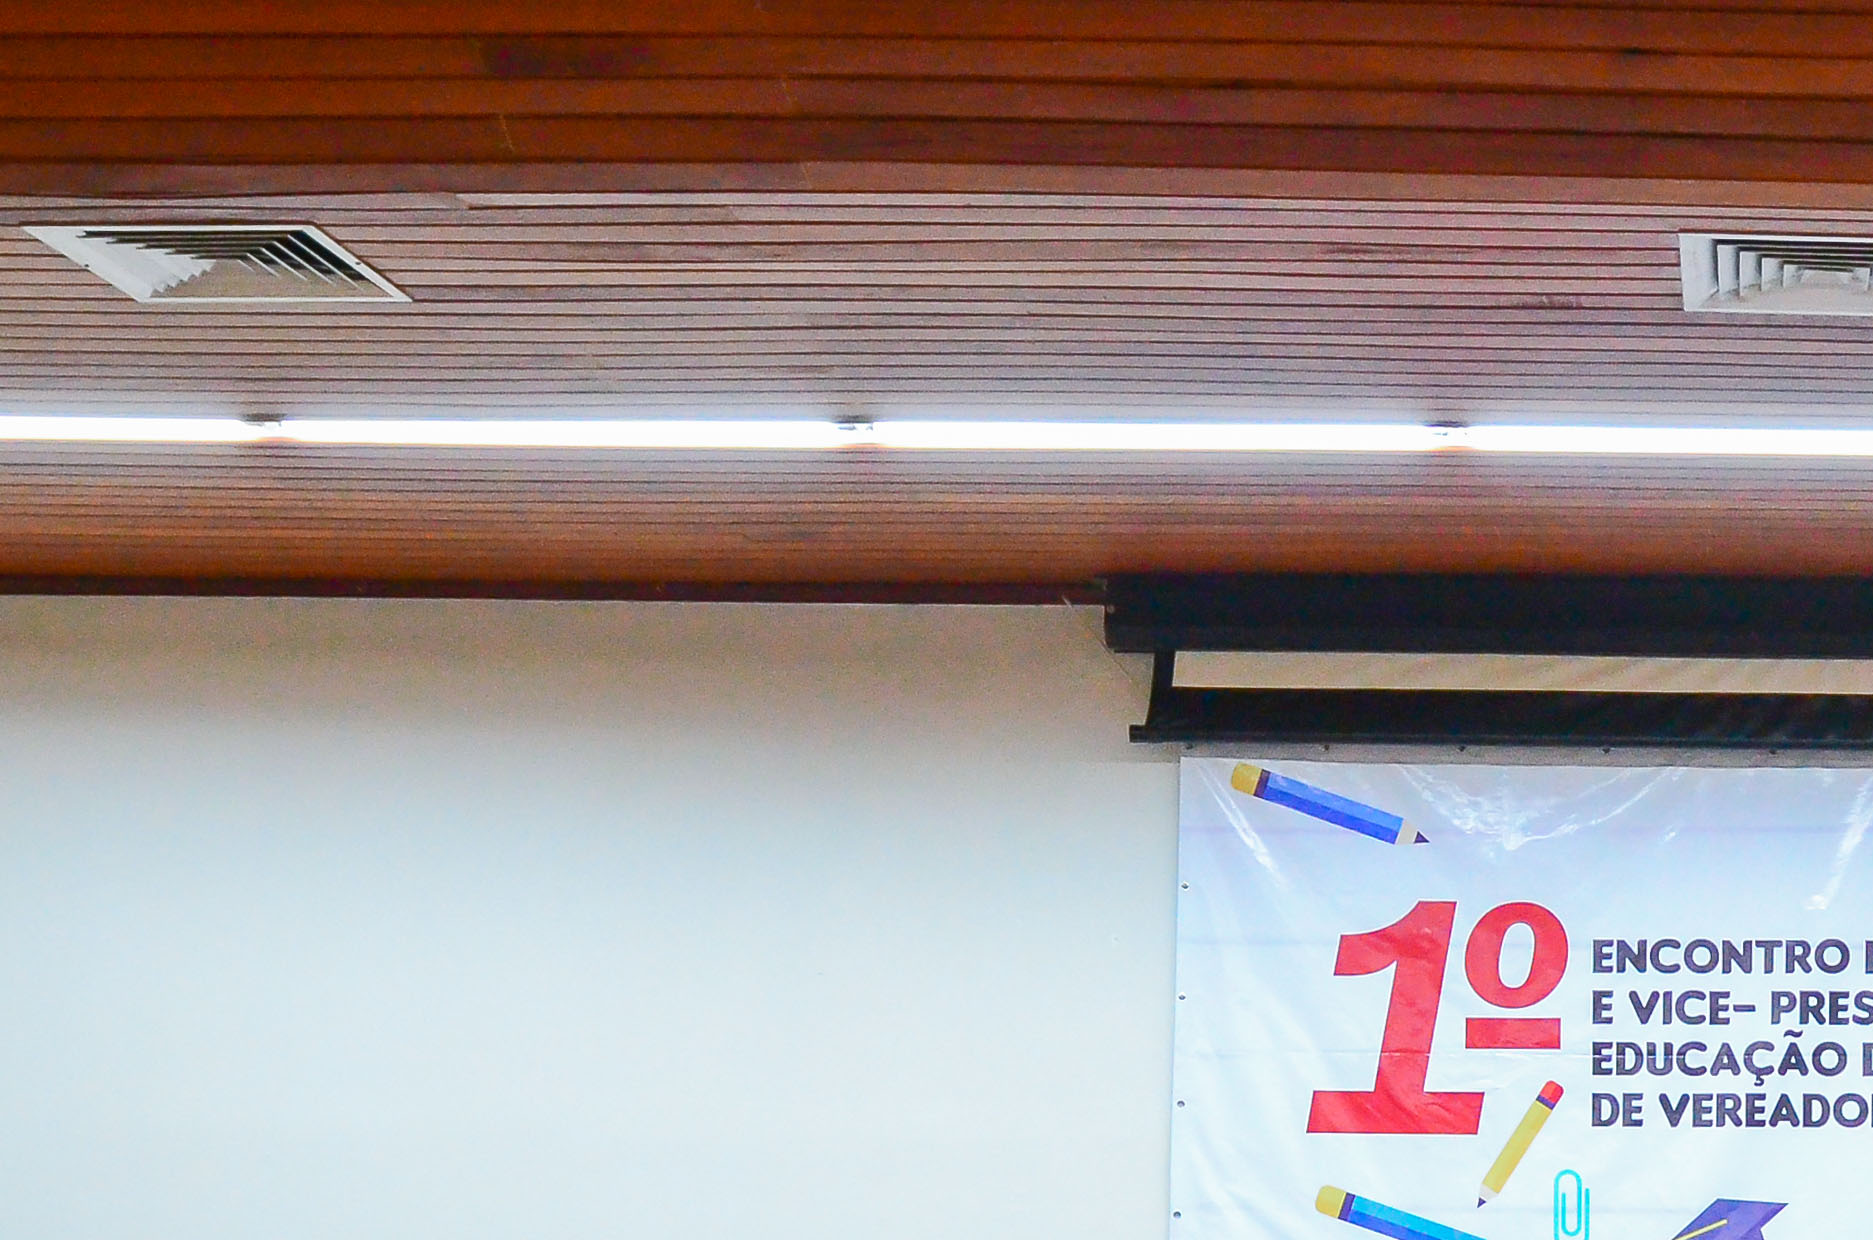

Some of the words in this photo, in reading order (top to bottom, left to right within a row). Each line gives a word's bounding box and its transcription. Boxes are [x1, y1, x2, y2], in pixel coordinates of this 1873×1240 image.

[1592, 939, 1850, 974] ENCONTRO
[1592, 990, 1614, 1025] E
[1628, 990, 1756, 1025] VICE-
[1592, 1030, 1848, 1086] EDUCAÇÃO
[1591, 1093, 1643, 1127] DE
